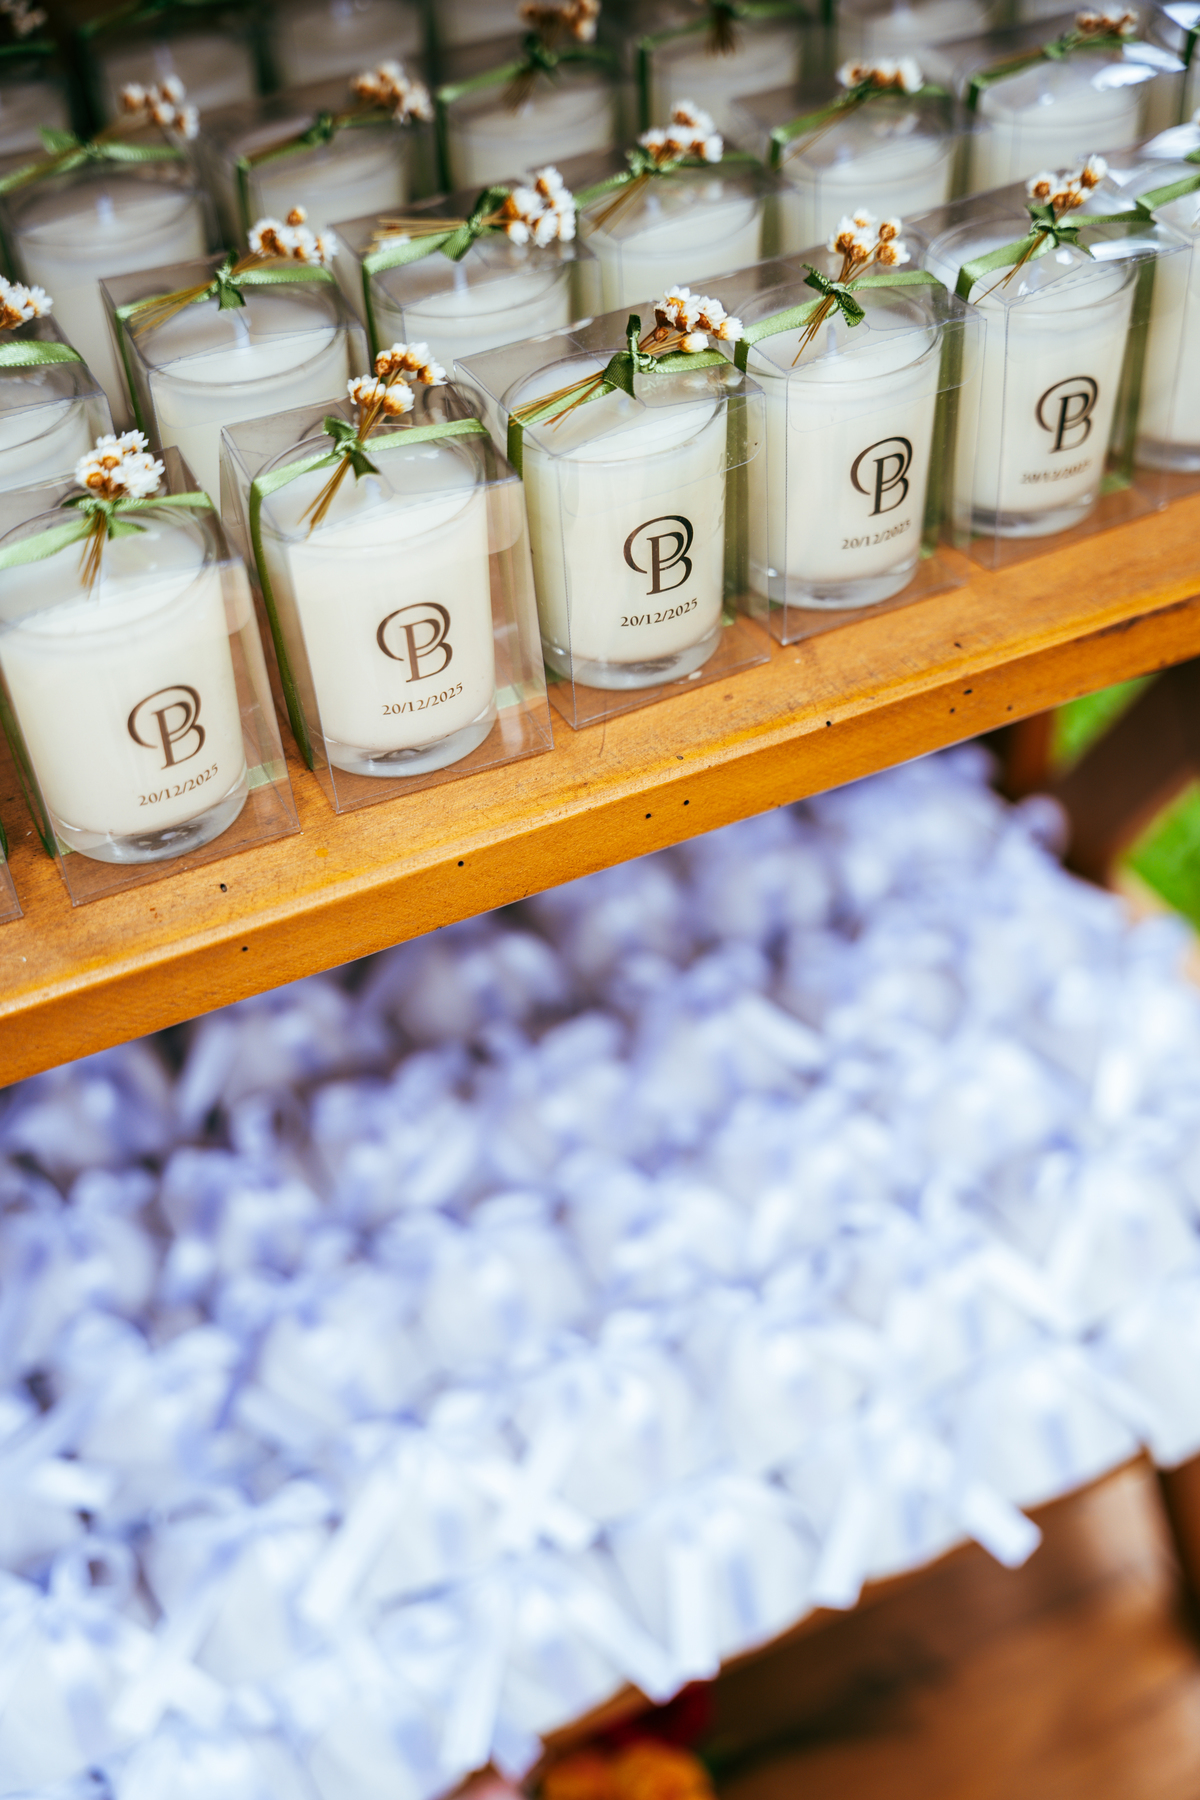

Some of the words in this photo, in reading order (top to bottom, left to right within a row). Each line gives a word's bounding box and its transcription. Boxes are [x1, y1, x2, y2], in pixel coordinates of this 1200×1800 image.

[621, 597, 698, 627] 20/12/2025
[382, 682, 463, 716] 20/12/2025
[139, 764, 219, 806] 20/12/2025
